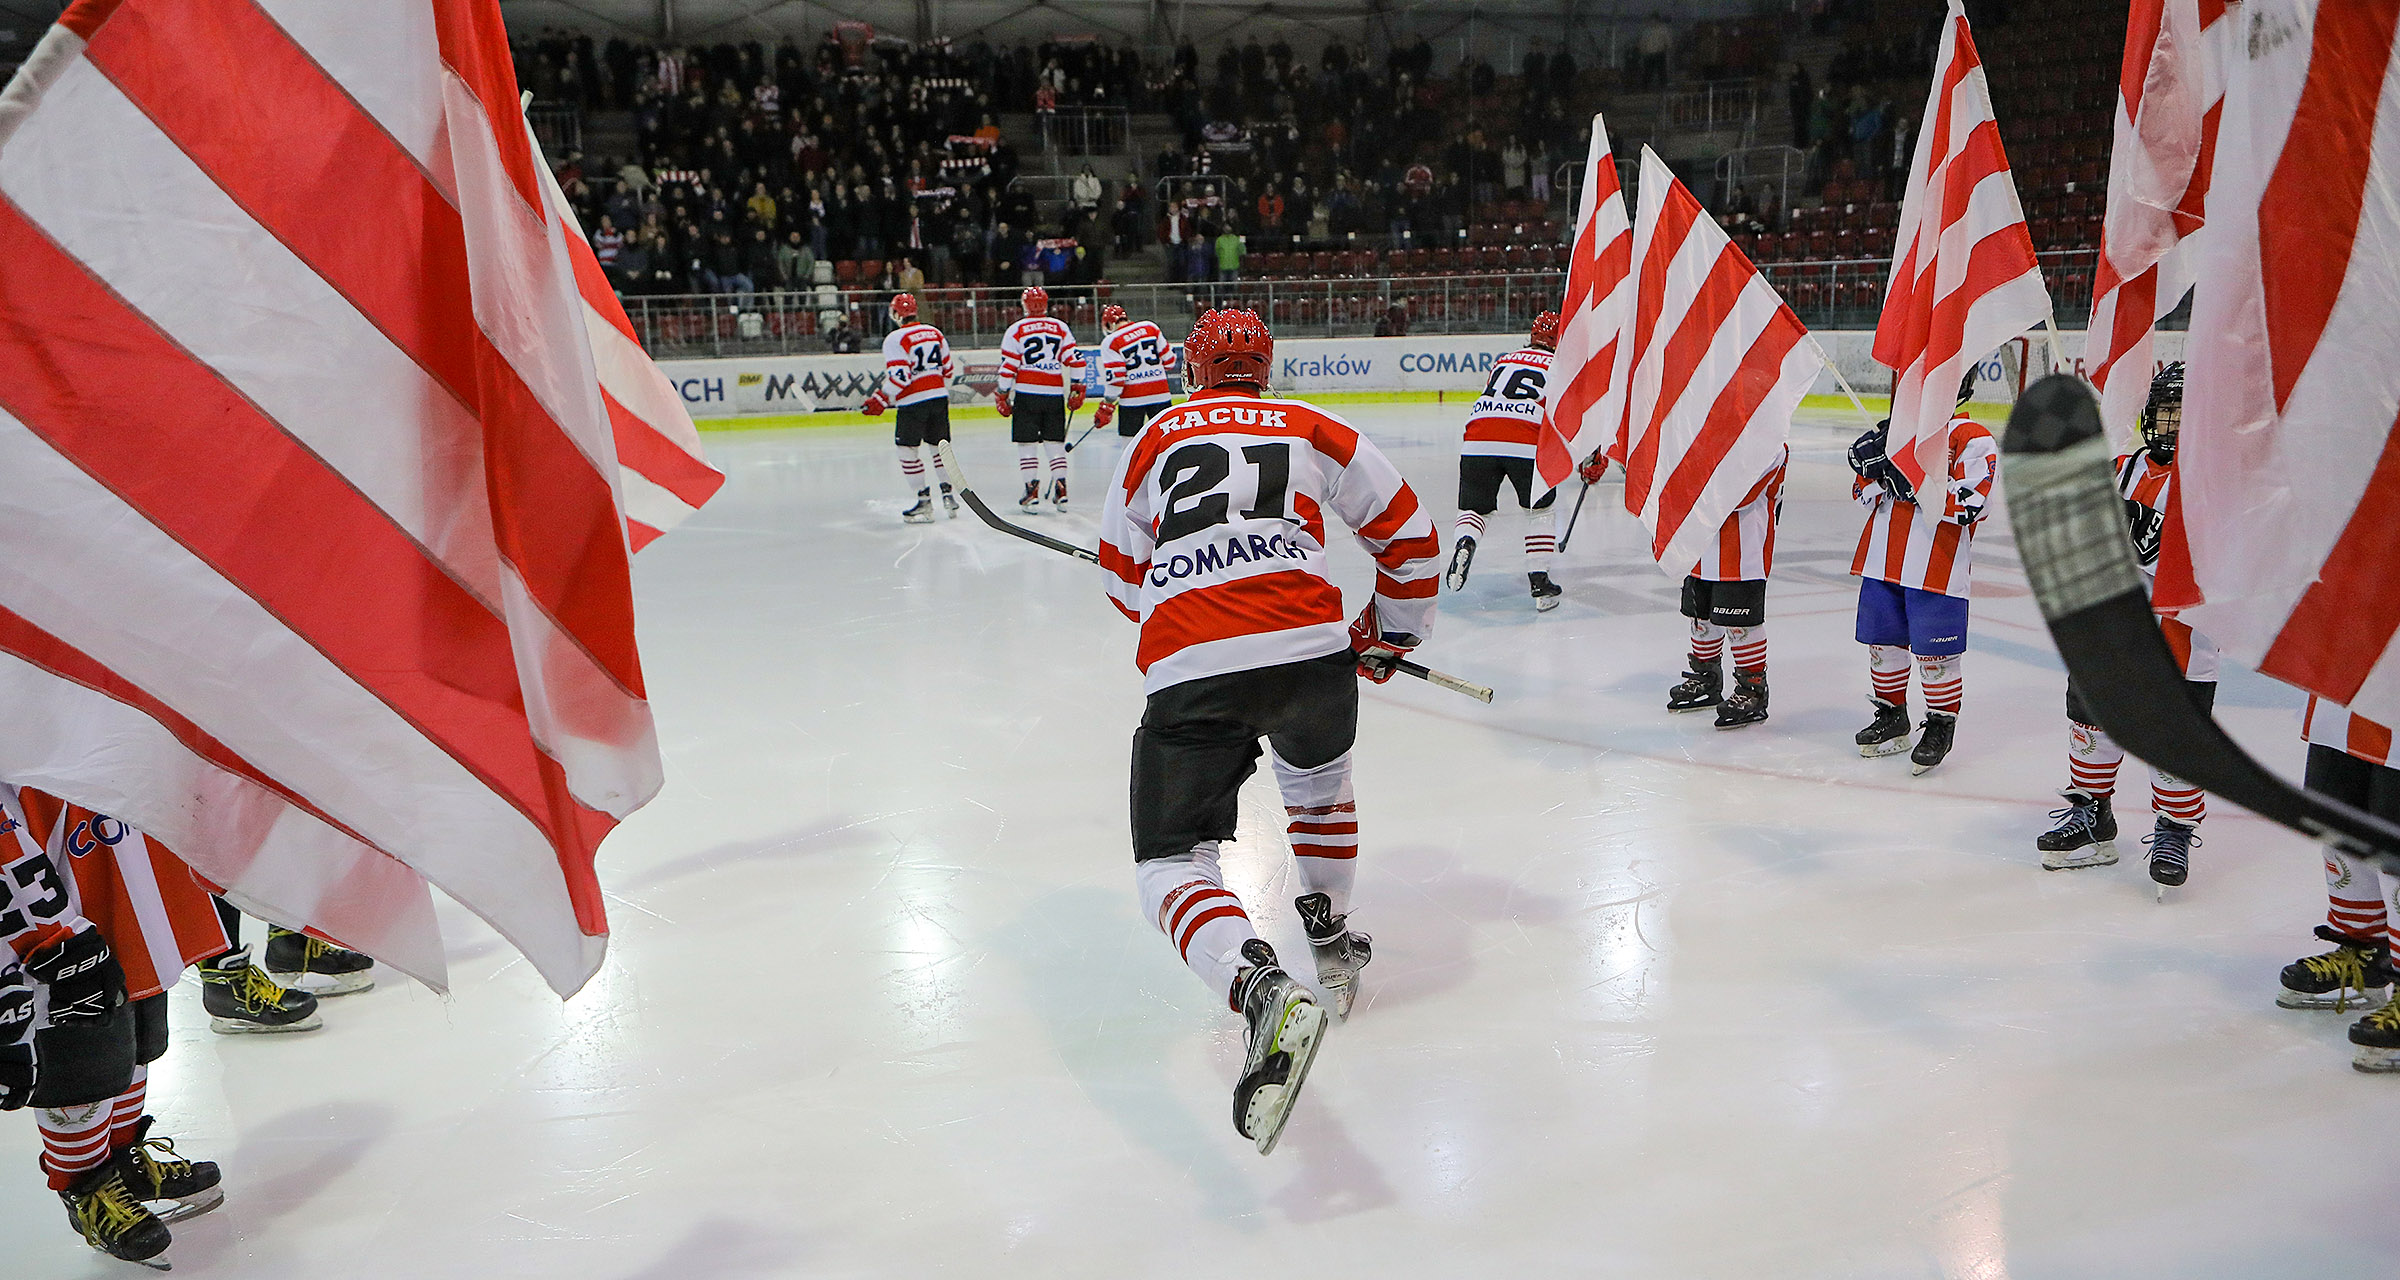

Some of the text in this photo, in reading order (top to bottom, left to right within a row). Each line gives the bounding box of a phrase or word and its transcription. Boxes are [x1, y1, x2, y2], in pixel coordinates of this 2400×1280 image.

[914, 343, 943, 371] 14
[1024, 336, 1062, 365] 27
[1122, 339, 1160, 371] 33
[1284, 353, 1371, 377] Kraków
[1481, 366, 1547, 399] 16
[1159, 407, 1288, 437] RACUK
[1155, 442, 1290, 550] 21
[1150, 534, 1308, 588] COMARCH
[1712, 606, 1750, 616] BAUER
[67, 813, 130, 858] CO
